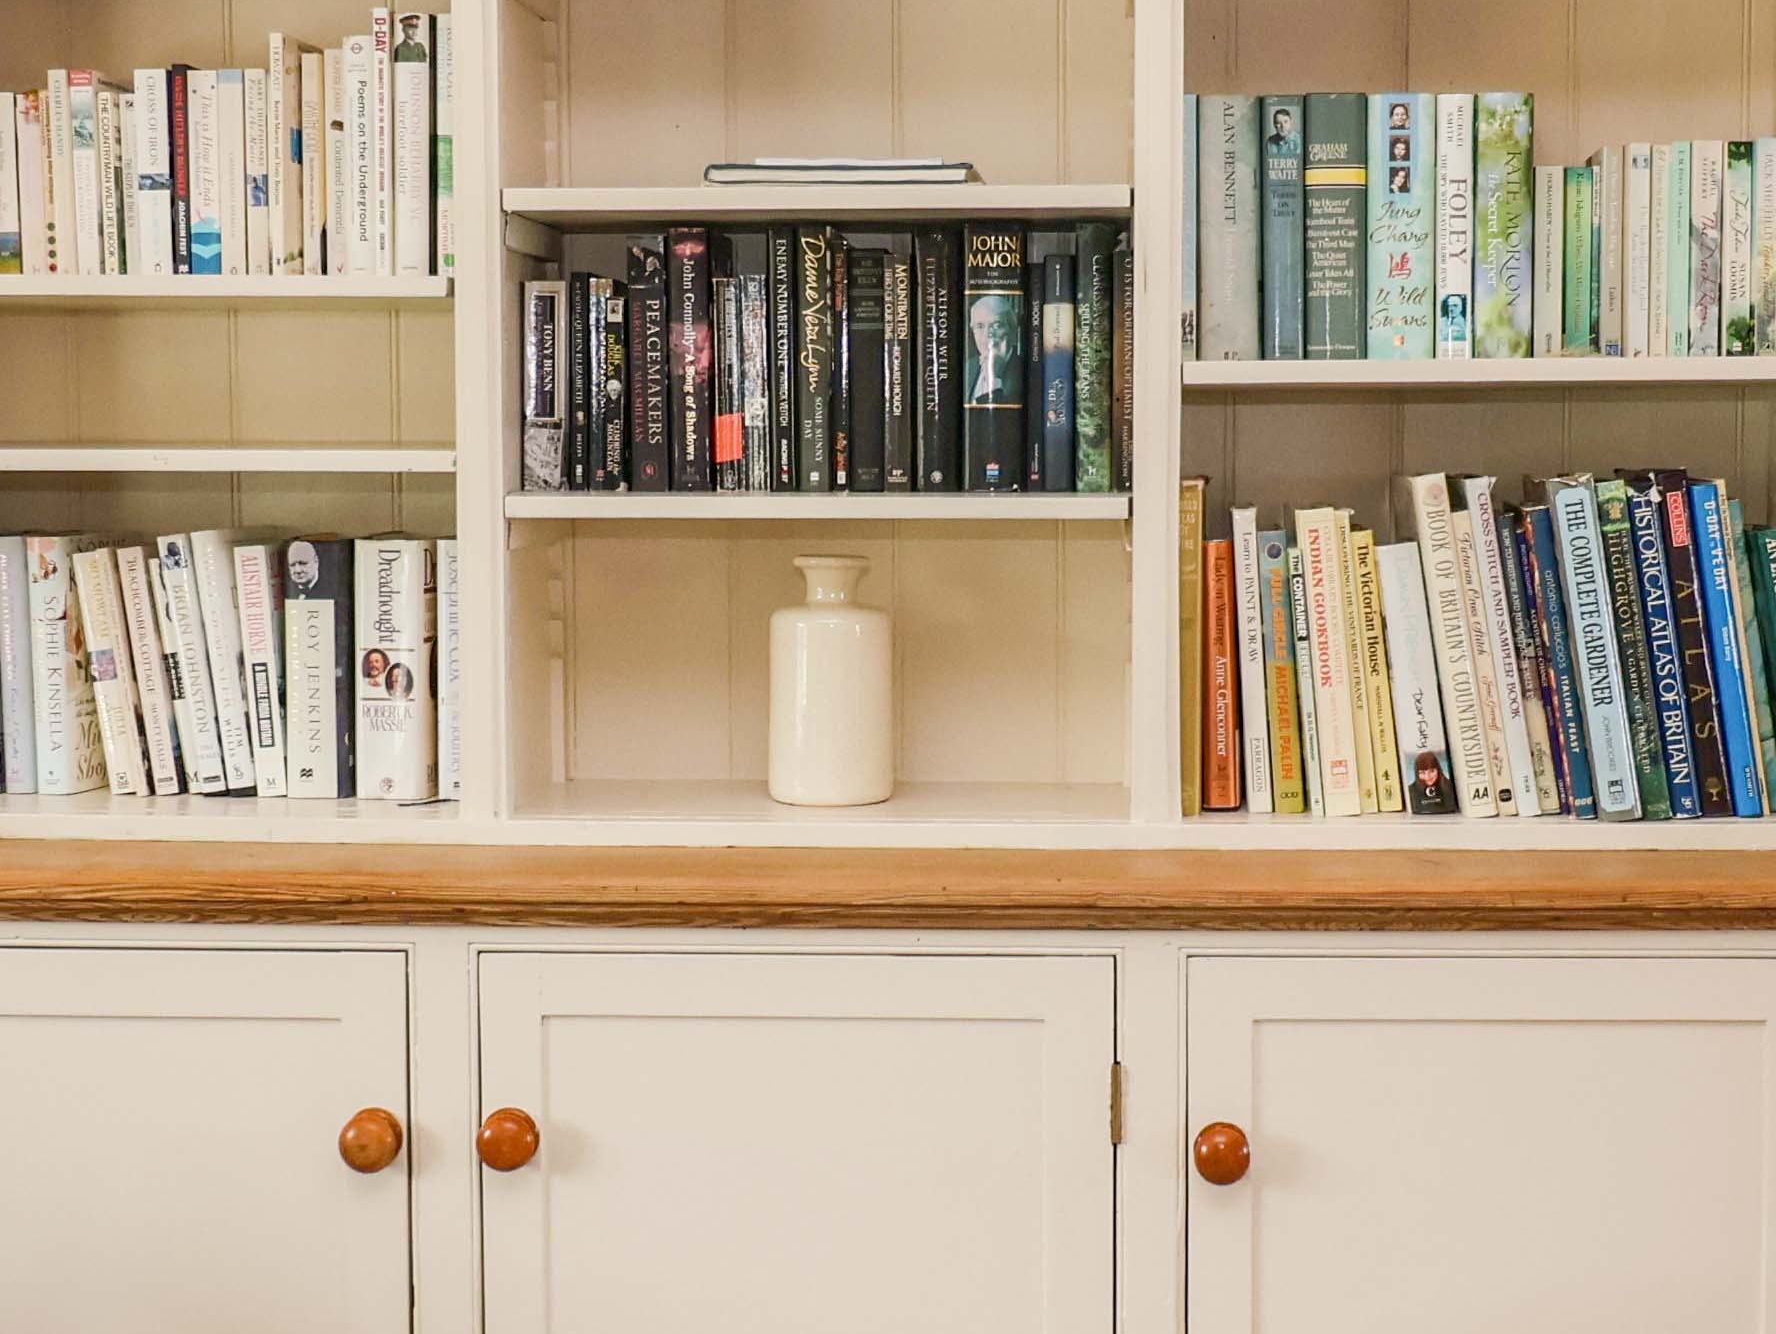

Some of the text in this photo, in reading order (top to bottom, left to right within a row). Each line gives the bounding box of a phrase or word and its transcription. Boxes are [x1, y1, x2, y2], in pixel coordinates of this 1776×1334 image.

[374, 17, 387, 53] D-DAY
[145, 75, 158, 113] CROSS
[148, 134, 159, 167] IRON
[1446, 112, 1454, 143] SMITH
[1455, 106, 1464, 147] MICHAEL
[355, 79, 369, 242] Poems on the Underground
[1223, 101, 1237, 224] ALAN BENNETT
[1268, 159, 1298, 169] TERRY
[1268, 170, 1298, 180] WAITE
[972, 235, 1016, 251] JOHN
[1369, 224, 1429, 250] Chang
[1448, 178, 1468, 265] FOLEY
[1499, 150, 1523, 308] KATE MORTON
[683, 259, 695, 289] John
[775, 239, 787, 280] ENEMY
[968, 252, 1021, 267] MAJOR
[682, 293, 696, 347] Connolly
[776, 284, 787, 336] NUMBER
[800, 233, 828, 393] Dame Vera Lynn
[895, 263, 908, 339] MOUNTBATTEN
[542, 322, 553, 391] TONY BENN
[777, 339, 787, 366] ONE
[938, 287, 948, 382] ALISON WEIR
[645, 298, 663, 445] PEACEMAKERS
[685, 410, 696, 461] Shadows
[803, 419, 813, 439] DAY
[1668, 496, 1686, 544] COLLINS
[1242, 532, 1254, 560] Learn
[242, 554, 267, 654] ALISTAIR HORNE
[373, 548, 402, 644] Dreadnought
[1244, 576, 1256, 612] PAINT
[1268, 567, 1283, 605] FULL
[1357, 544, 1383, 677] The Victorian House
[1475, 491, 1521, 720] CROSS STITCH AND SAMPLER BOOK
[1564, 498, 1614, 707] THE COMPLETE GARDENER
[171, 584, 210, 734] BRIAN JOHNSTON
[1247, 627, 1259, 663] DRAW
[1425, 508, 1486, 779] BOOK OF BRITAIN'S COUNTRYSIDE
[1631, 496, 1691, 784] HISTORICAL ATLAS OF BRITAIN
[1675, 579, 1716, 740] ATLAS
[43, 595, 64, 752] SOPHIE KINSELLA
[304, 609, 322, 754] ROY JENKINS
[1214, 655, 1227, 686] Anne
[1273, 665, 1291, 731] MICHAEL
[1560, 676, 1575, 718] ITALIAN
[1214, 689, 1229, 757] Glenconner
[1567, 722, 1580, 754] FEAST
[1278, 735, 1294, 780] PALIN
